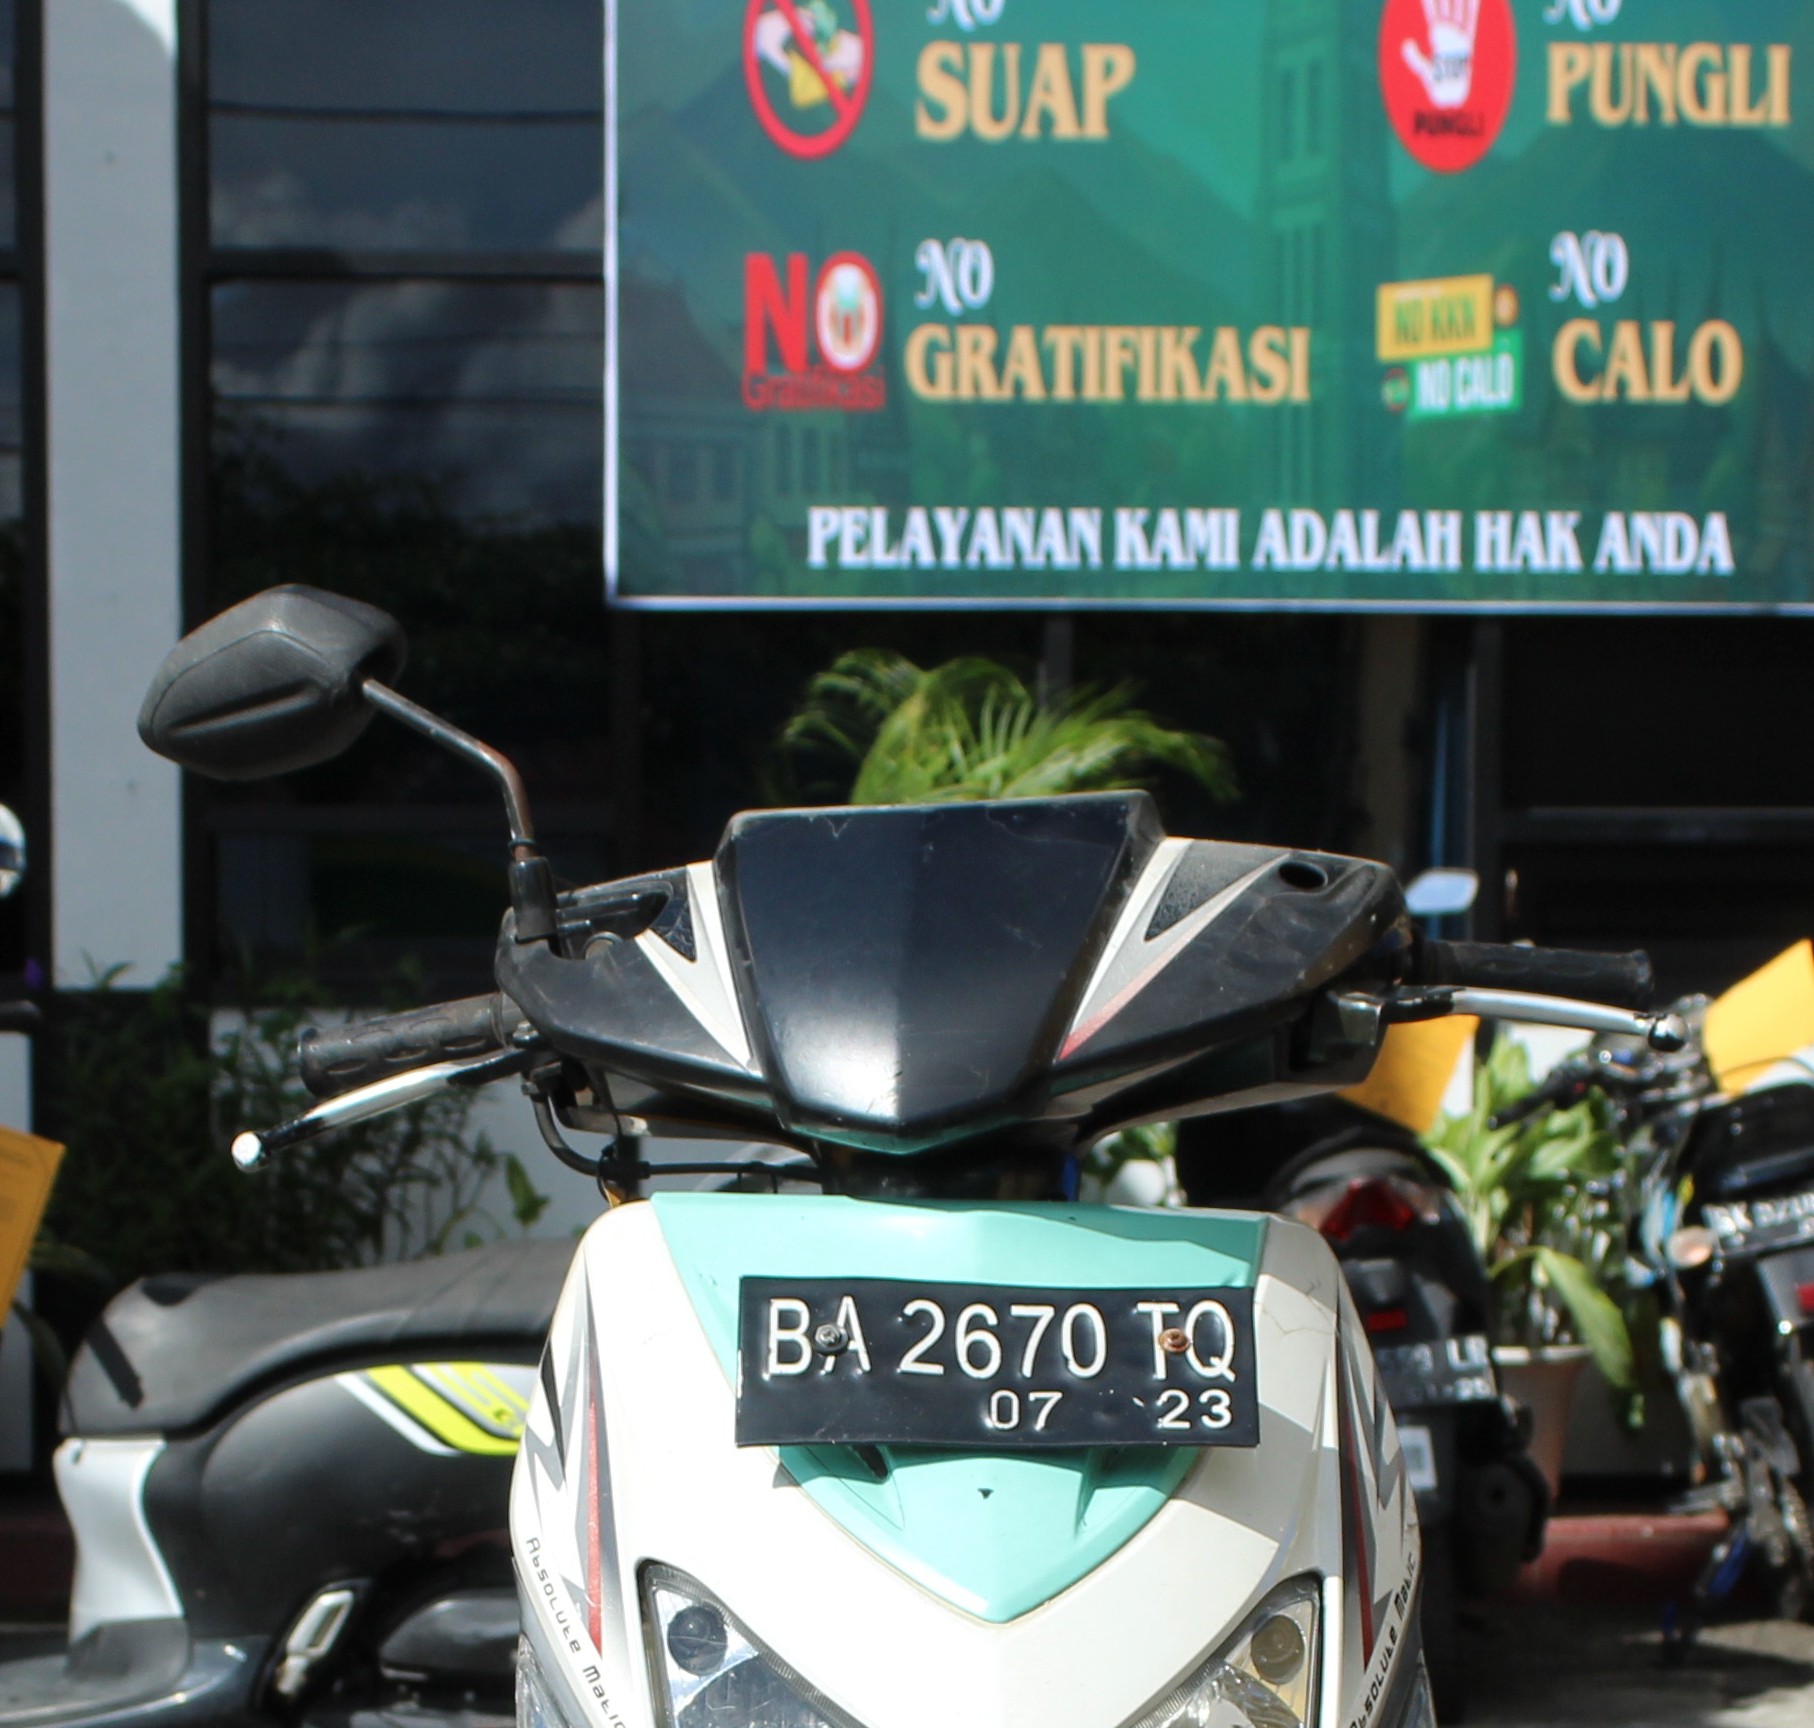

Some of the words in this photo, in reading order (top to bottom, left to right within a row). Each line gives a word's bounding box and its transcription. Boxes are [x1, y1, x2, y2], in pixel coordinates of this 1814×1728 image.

[914, 39, 1137, 142] SUAP
[1545, 40, 1793, 127] PUNGLI
[914, 237, 994, 316] NO
[1549, 229, 1629, 308] NO
[904, 322, 1311, 403] GRATIFIKASI
[1552, 317, 1744, 405] CALO
[806, 506, 1102, 570] PELAYANAN
[1113, 508, 1240, 571] KAMI
[1251, 508, 1463, 573] ADALAH
[1473, 510, 1583, 573] HAK
[1593, 511, 1736, 575] ANDA
[765, 1296, 871, 1377] BA
[898, 1299, 1106, 1380] 2670
[1136, 1299, 1236, 1383] TQ
[986, 1390, 1064, 1430] 07
[1157, 1389, 1233, 1430] 23
